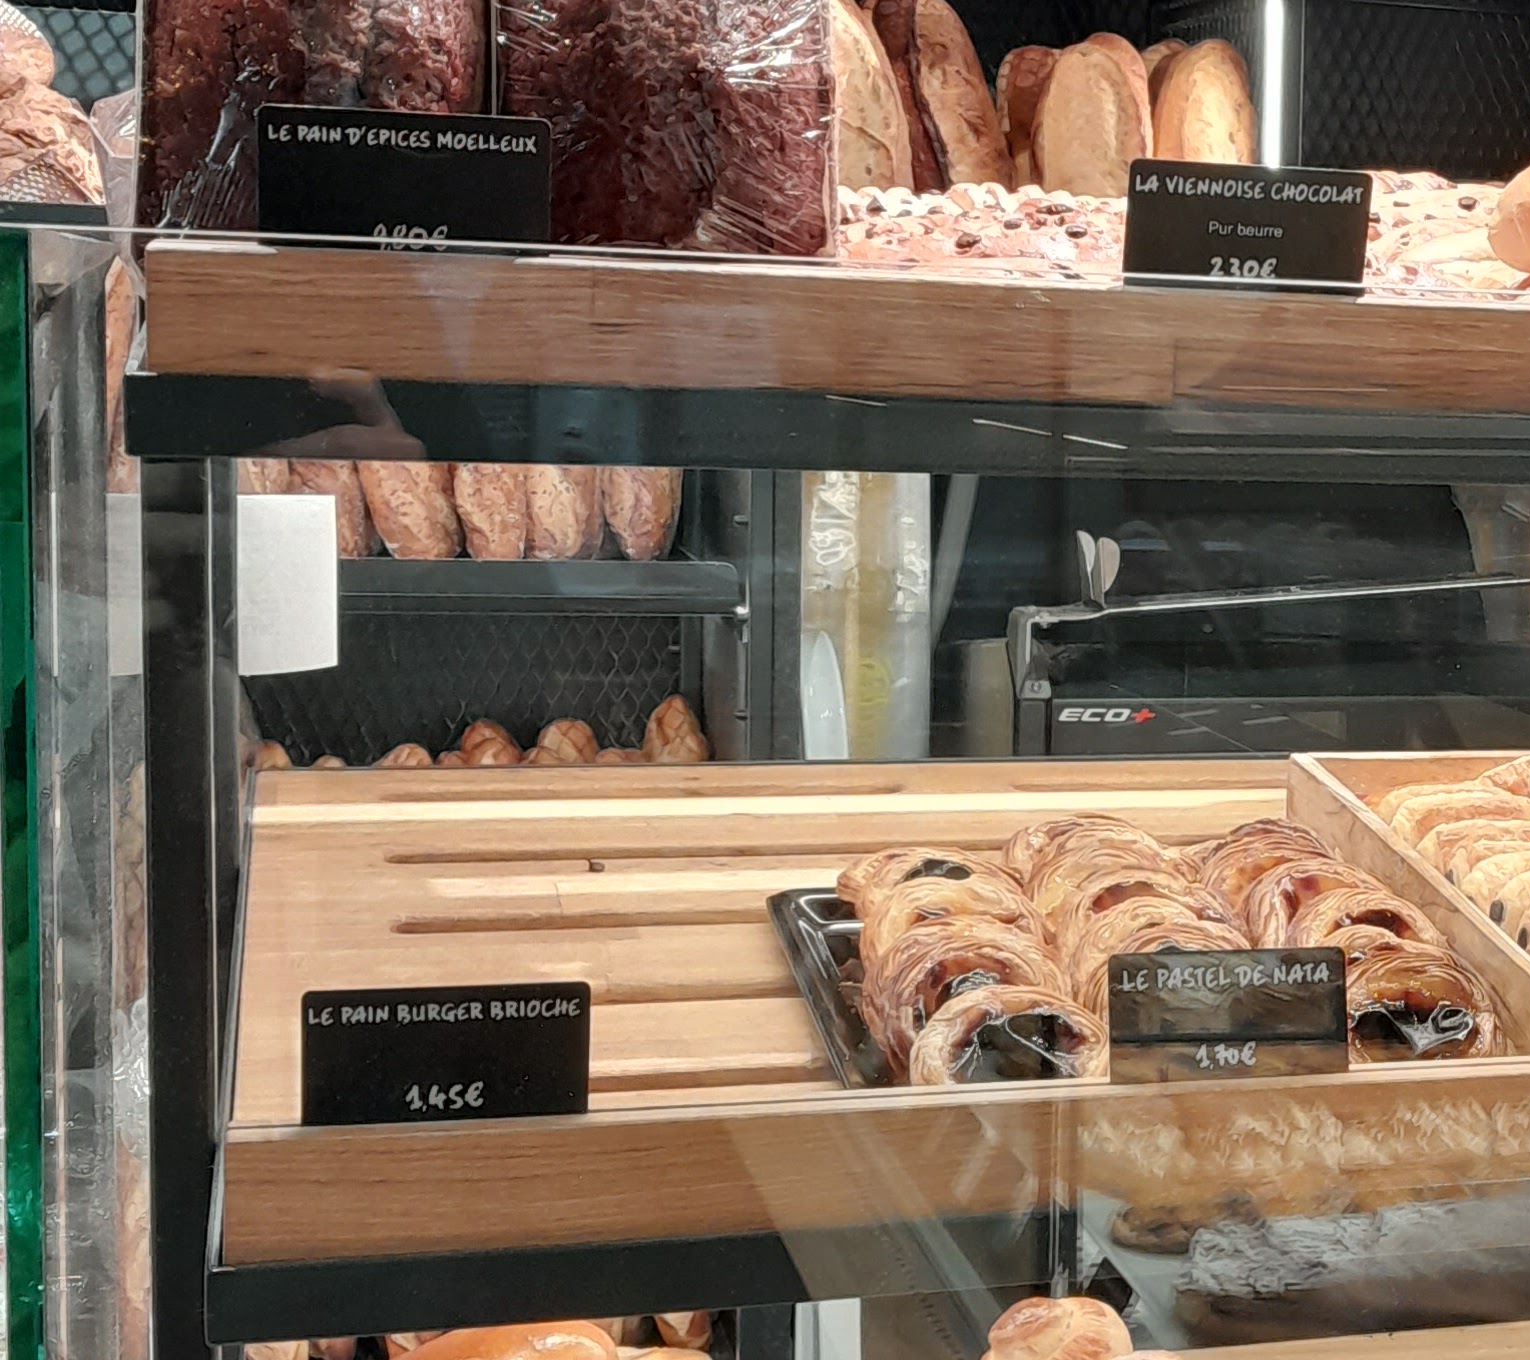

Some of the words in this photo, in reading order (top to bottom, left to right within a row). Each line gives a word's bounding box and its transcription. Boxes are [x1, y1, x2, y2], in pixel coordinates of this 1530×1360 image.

[268, 124, 290, 141] LE
[298, 125, 341, 143] PAIN
[346, 126, 430, 148] D'EPICES
[437, 131, 537, 154] MOELLEUX
[1135, 174, 1158, 192] LA
[1165, 175, 1265, 200] VIENNOISE
[1270, 182, 1364, 204] CHOCOLAT
[1208, 221, 1233, 235] Pur
[1237, 222, 1283, 238] beurre
[1122, 970, 1149, 991] LE
[1157, 966, 1231, 988] PASTEL
[1234, 965, 1266, 985] DE
[1274, 962, 1329, 984] NATA
[309, 1007, 334, 1026] LE
[341, 1005, 389, 1024] PAIN
[397, 1002, 484, 1025] BURGER
[490, 998, 581, 1020] BRIOCHE
[1196, 1041, 1257, 1069] 1,70€
[405, 1081, 485, 1112] 1,45€
